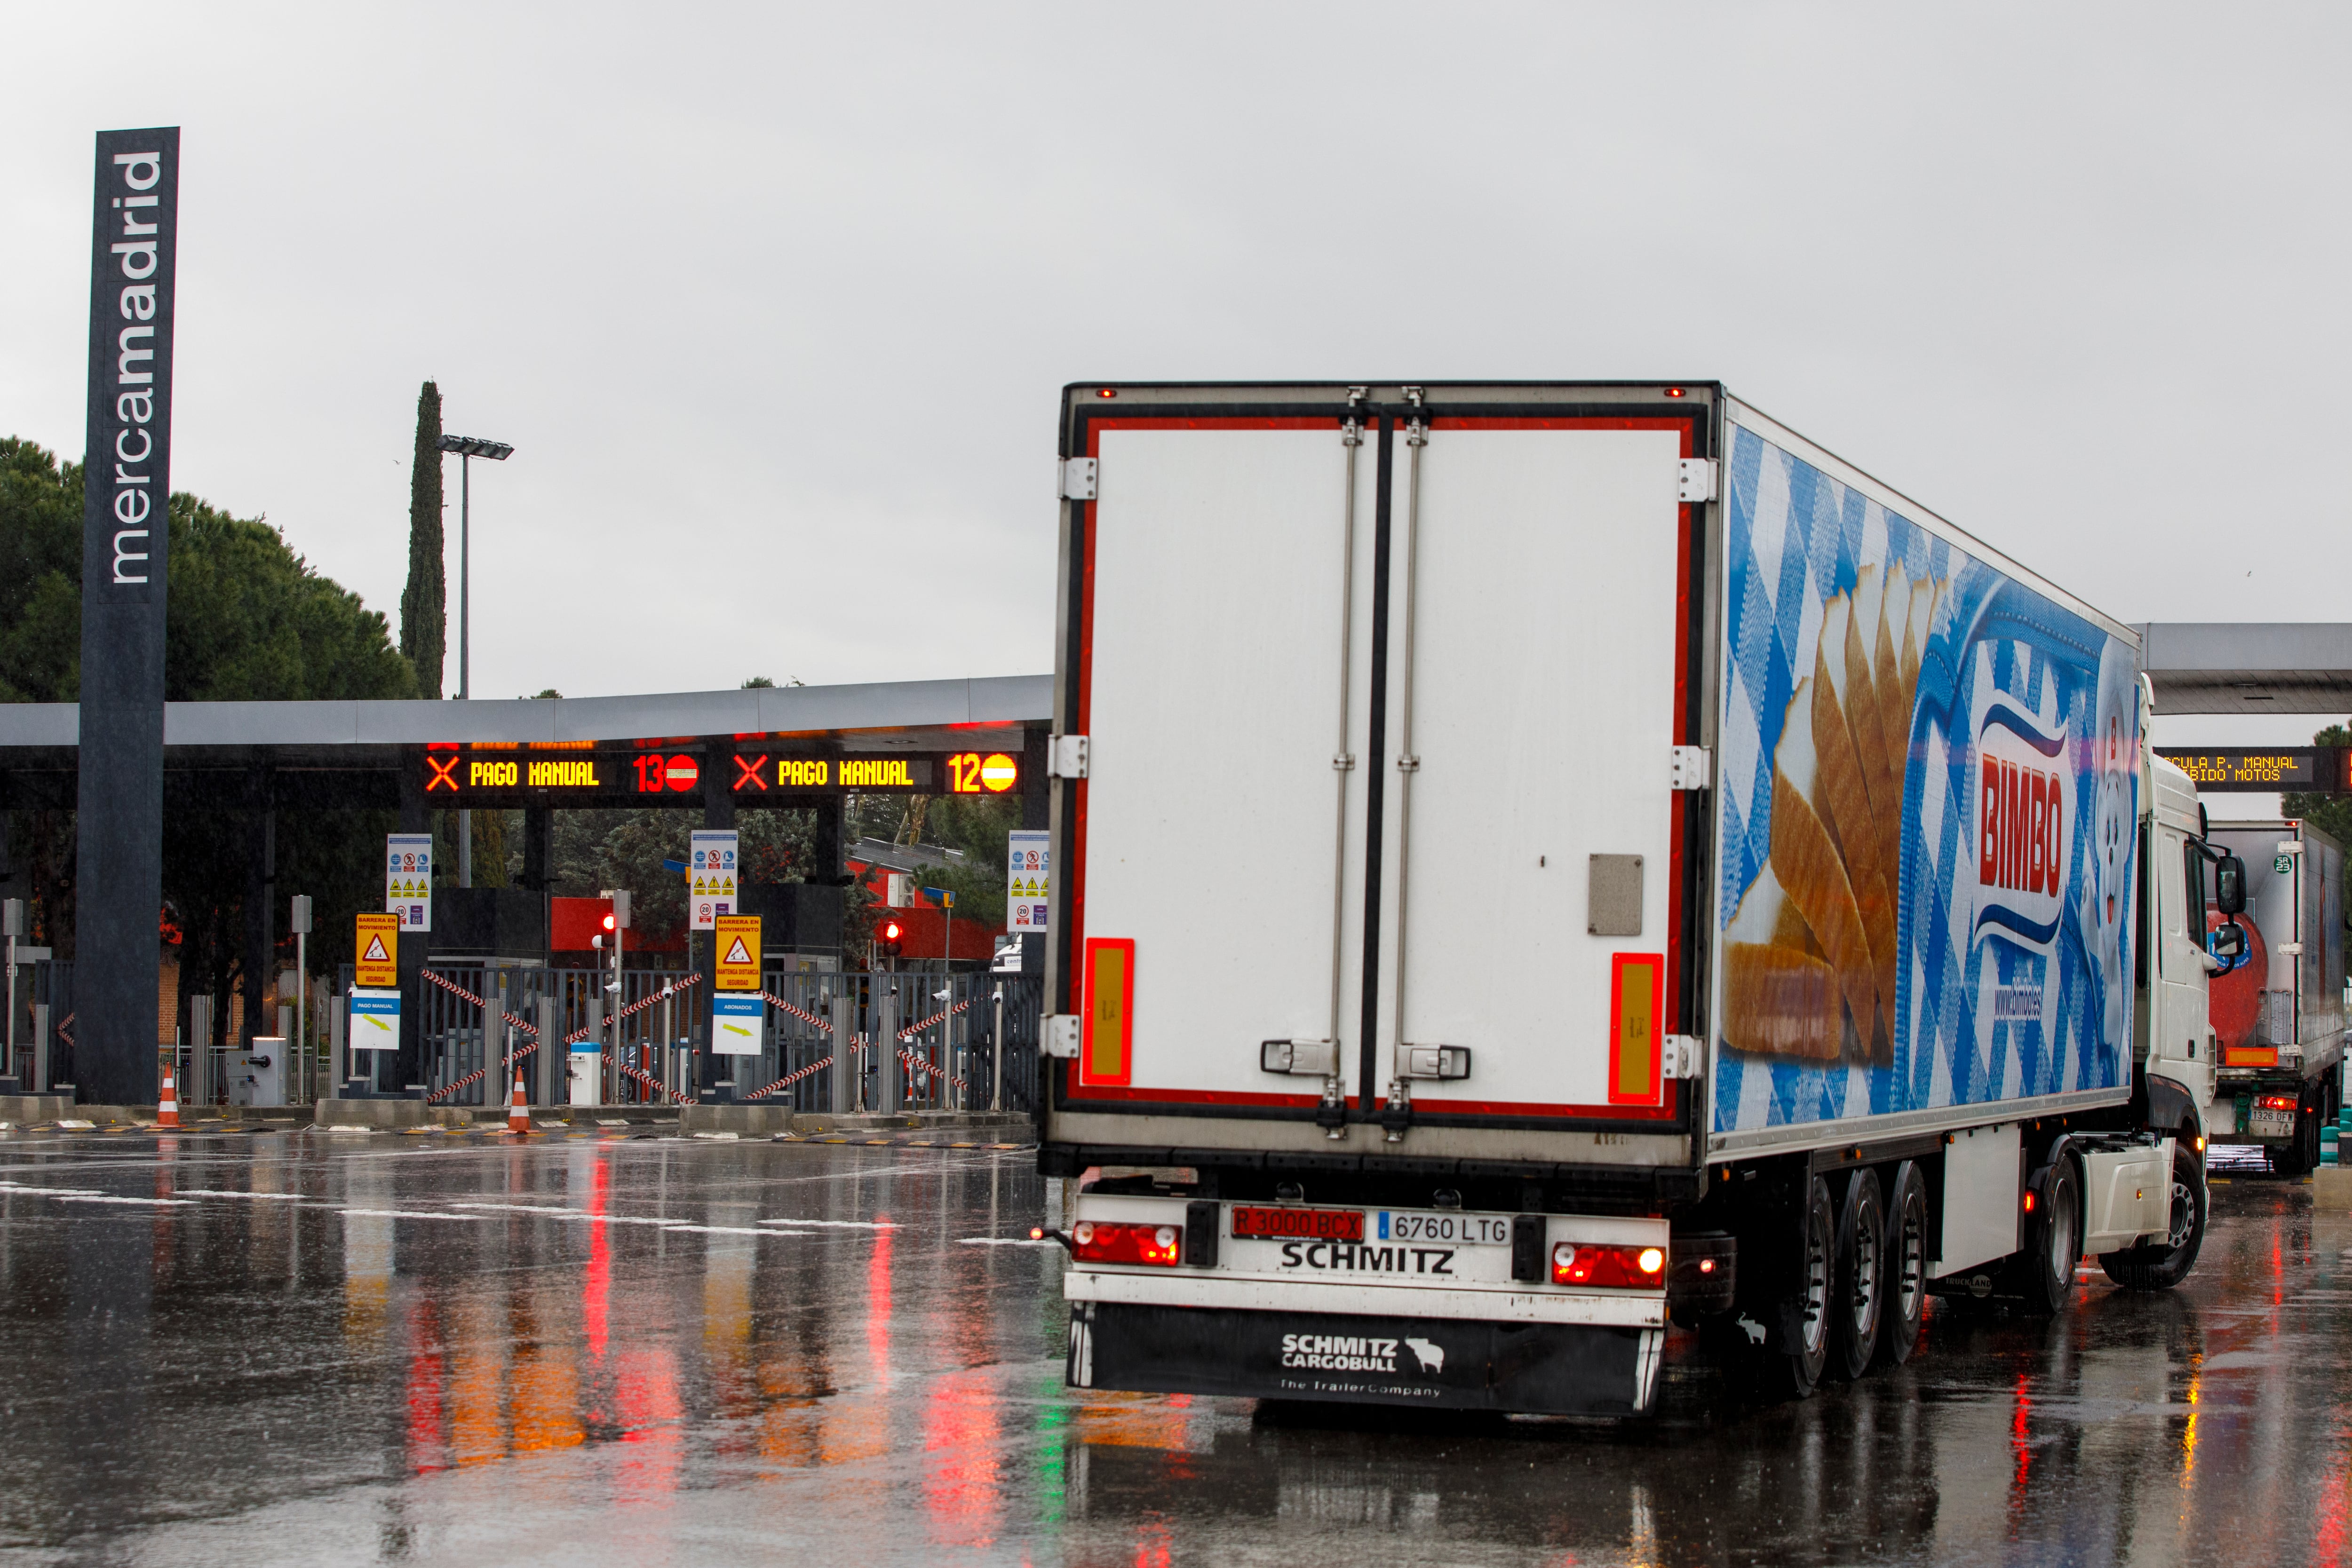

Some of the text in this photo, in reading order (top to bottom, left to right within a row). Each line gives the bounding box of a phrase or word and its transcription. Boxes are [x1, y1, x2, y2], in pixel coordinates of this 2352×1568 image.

[113, 151, 161, 584] mercamadrid
[470, 761, 599, 786] PAGO MANUAL
[633, 754, 664, 792] 13
[779, 761, 914, 785] PAGO MANUAL
[947, 752, 981, 792] 12
[2164, 756, 2298, 768] CULA P. MANUAL
[2235, 769, 2280, 781] MOTOS
[1979, 752, 2062, 898] BIMBO
[1995, 982, 2041, 1016] www.bimbo.es
[2253, 1111, 2273, 1120] 1326
[1236, 1209, 1359, 1236] R 3000 BCX
[1395, 1216, 1505, 1241] 6760 LTG
[1281, 1242, 1454, 1274] SCHMITZ
[1945, 1277, 1991, 1287] TRUCKLAND
[1282, 1334, 1398, 1357] SCHMITZ
[1282, 1353, 1397, 1372] CARGOBULL
[1281, 1379, 1306, 1389] The
